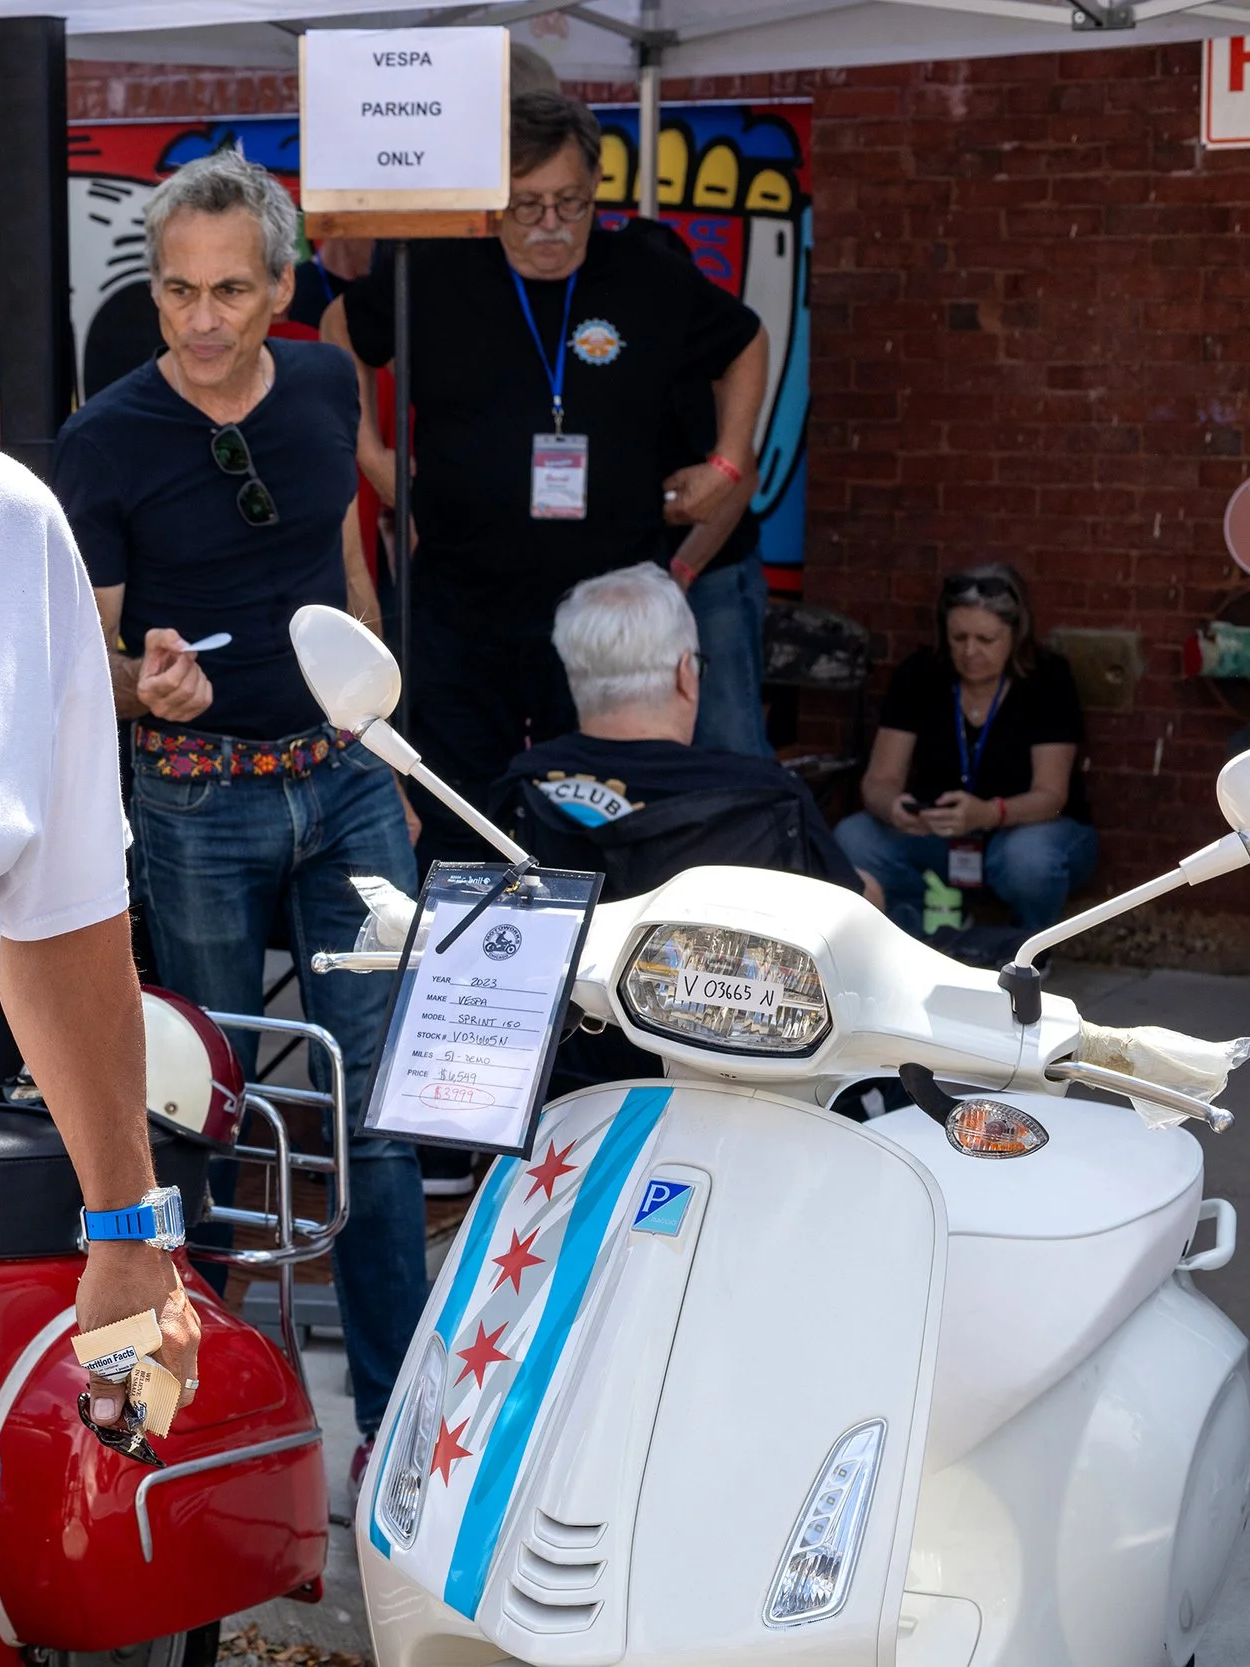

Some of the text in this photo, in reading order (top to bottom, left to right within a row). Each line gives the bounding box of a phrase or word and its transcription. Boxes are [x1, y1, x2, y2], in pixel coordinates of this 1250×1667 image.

[373, 51, 432, 67] VESPA
[361, 101, 442, 117] PARKING
[377, 151, 425, 166] ONLY
[554, 783, 621, 815] CLUB
[432, 975, 498, 988] YEAR 2023
[684, 975, 775, 1007] V 03665 N
[426, 994, 488, 1006] MAKE VESPA
[421, 1012, 521, 1029] MODEL SPRINT 150
[411, 1049, 434, 1059] MILES
[465, 1054, 491, 1064] DEMO
[407, 1068, 429, 1078] PRICE
[434, 1085, 474, 1103] $3999
[642, 1183, 671, 1212] P
[82, 1349, 135, 1370] utrition Facts
